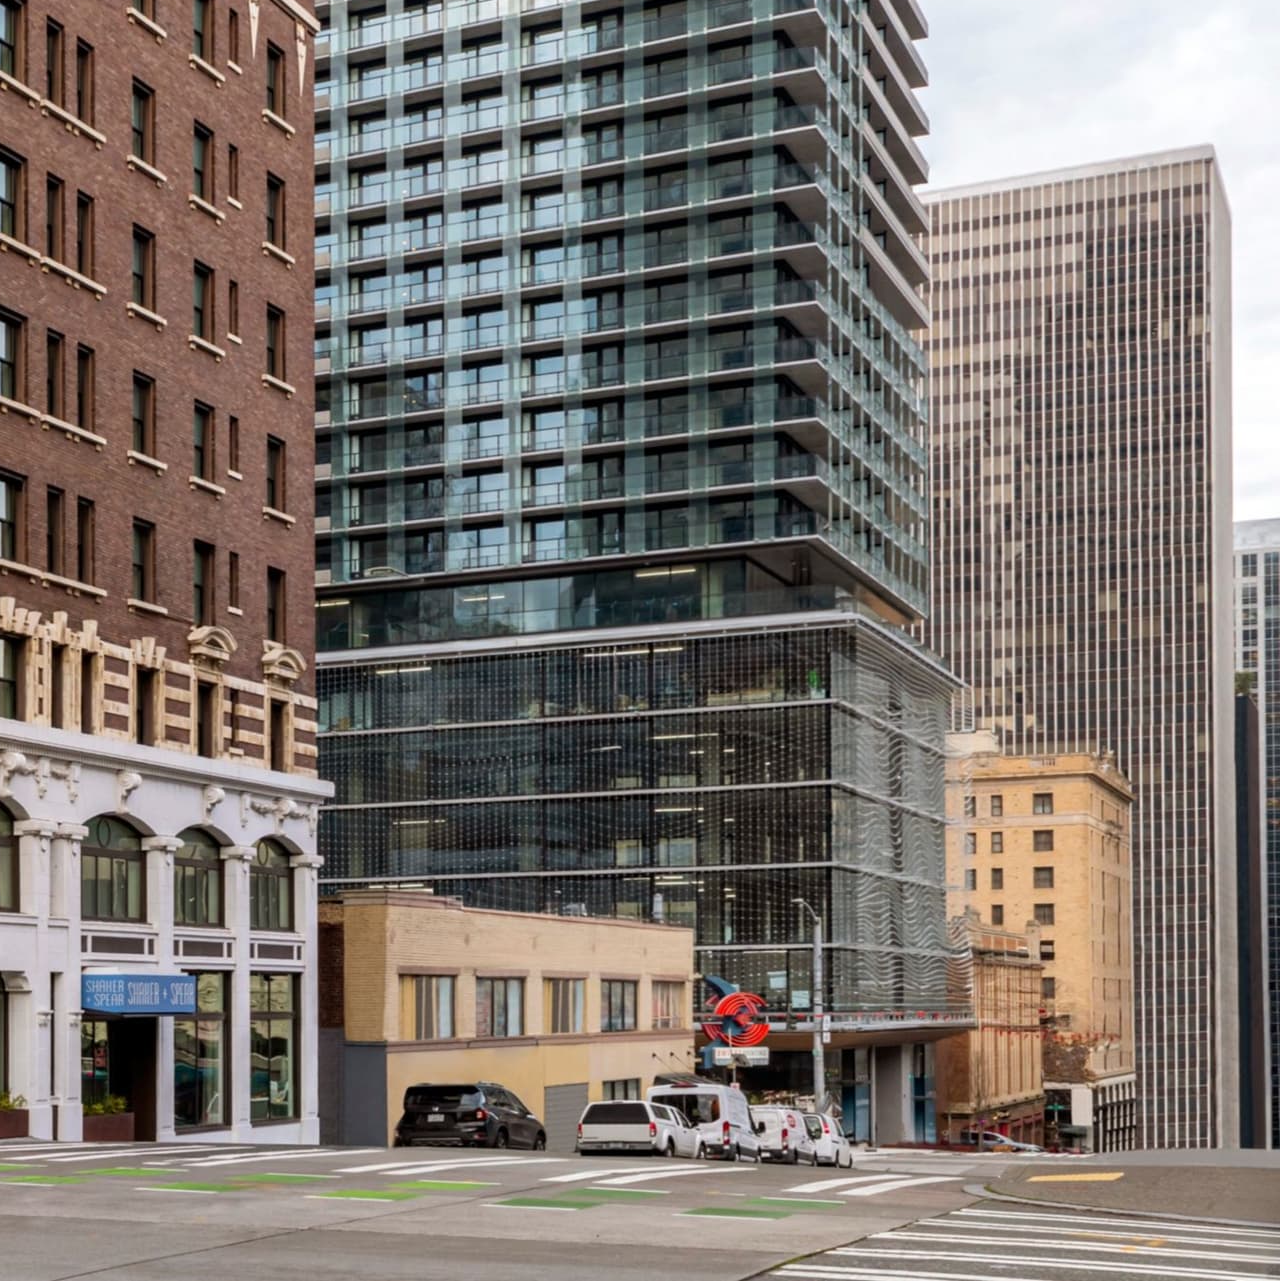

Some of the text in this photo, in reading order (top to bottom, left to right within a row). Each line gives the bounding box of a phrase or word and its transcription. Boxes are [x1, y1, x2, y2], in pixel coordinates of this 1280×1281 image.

[86, 979, 125, 993] SHAKER
[94, 993, 125, 1006] SPEAR
[127, 982, 160, 1005] SHAKER
[170, 983, 195, 1005] SPEAR
